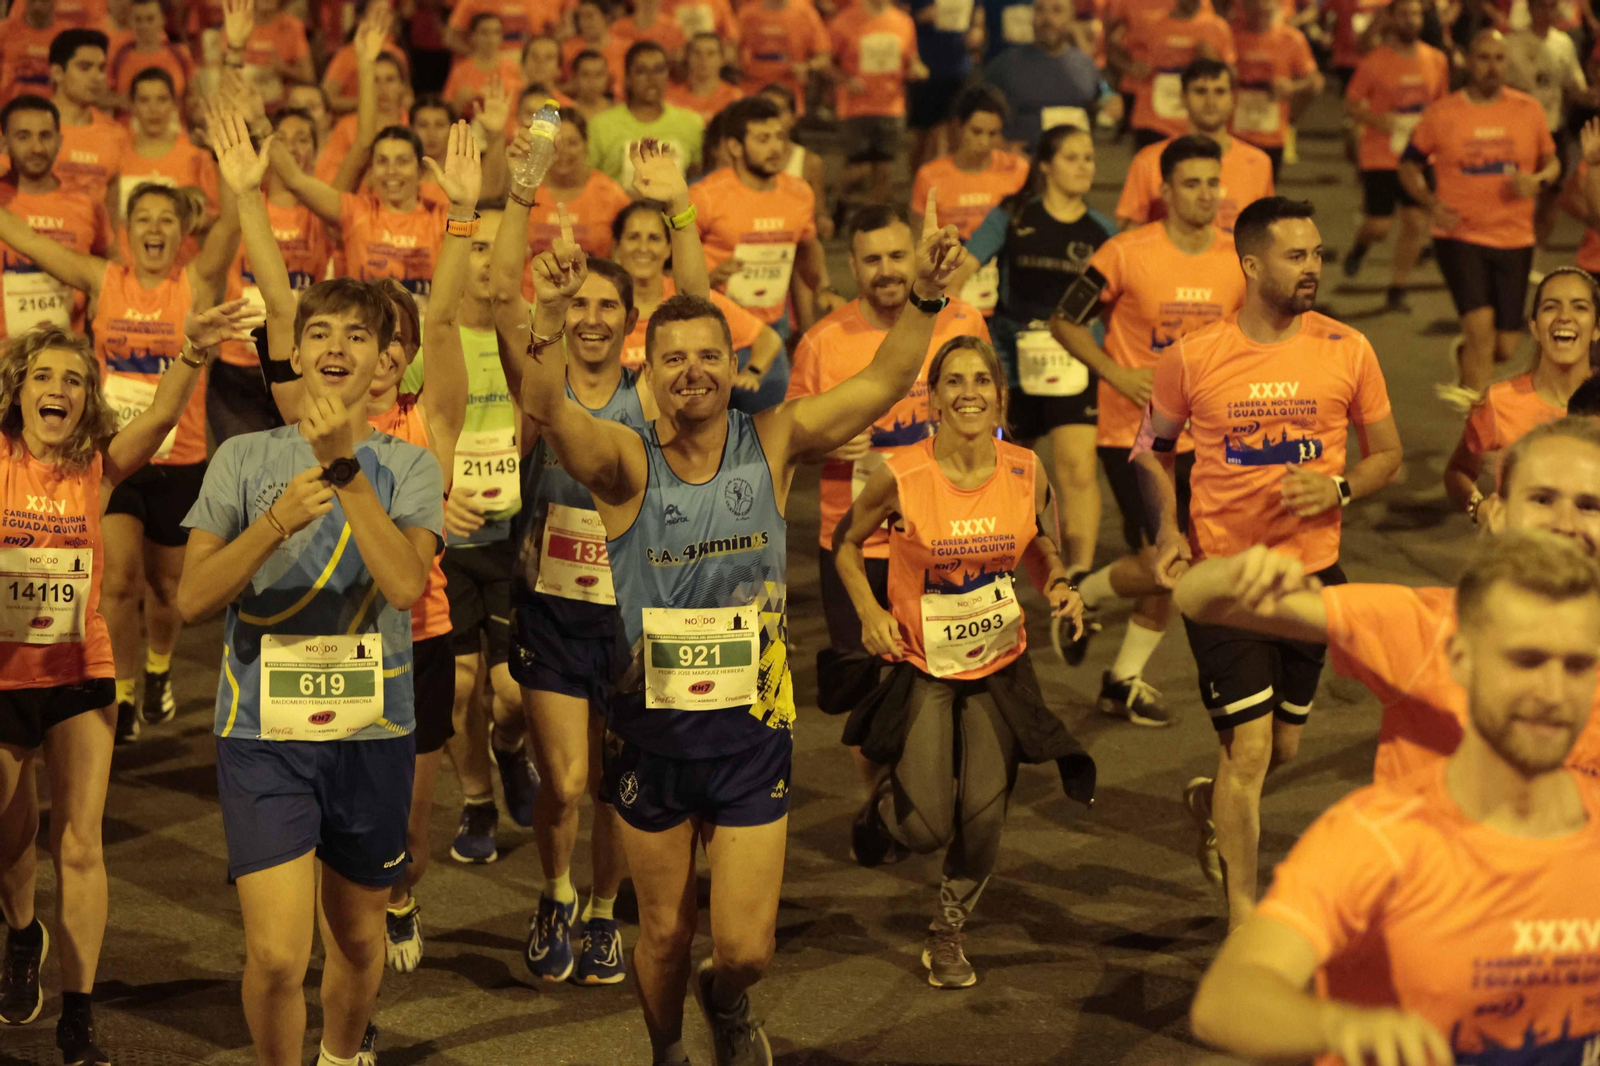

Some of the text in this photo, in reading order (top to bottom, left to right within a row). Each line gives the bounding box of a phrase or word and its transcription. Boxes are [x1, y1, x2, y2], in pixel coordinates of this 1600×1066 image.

[19, 296, 64, 312] 21647
[1249, 381, 1299, 399] XXXV
[1227, 399, 1317, 409] CARRERA NOCTURNA
[1233, 407, 1317, 418] GUADALQUIVIR
[463, 457, 517, 476] 21149
[4, 508, 44, 521] CARRERA
[949, 516, 997, 537] XXXV
[3, 533, 35, 548] KH7
[931, 533, 1016, 547] CARRERA NOCTURNA
[937, 541, 1016, 557] GUADALQUIVIR
[9, 581, 75, 603] 14119
[943, 613, 1004, 641] 12093
[678, 644, 721, 667] 921
[299, 673, 345, 696] 619
[691, 683, 711, 692] KH7
[311, 713, 331, 722] KH7
[1513, 919, 1600, 953] XXXV
